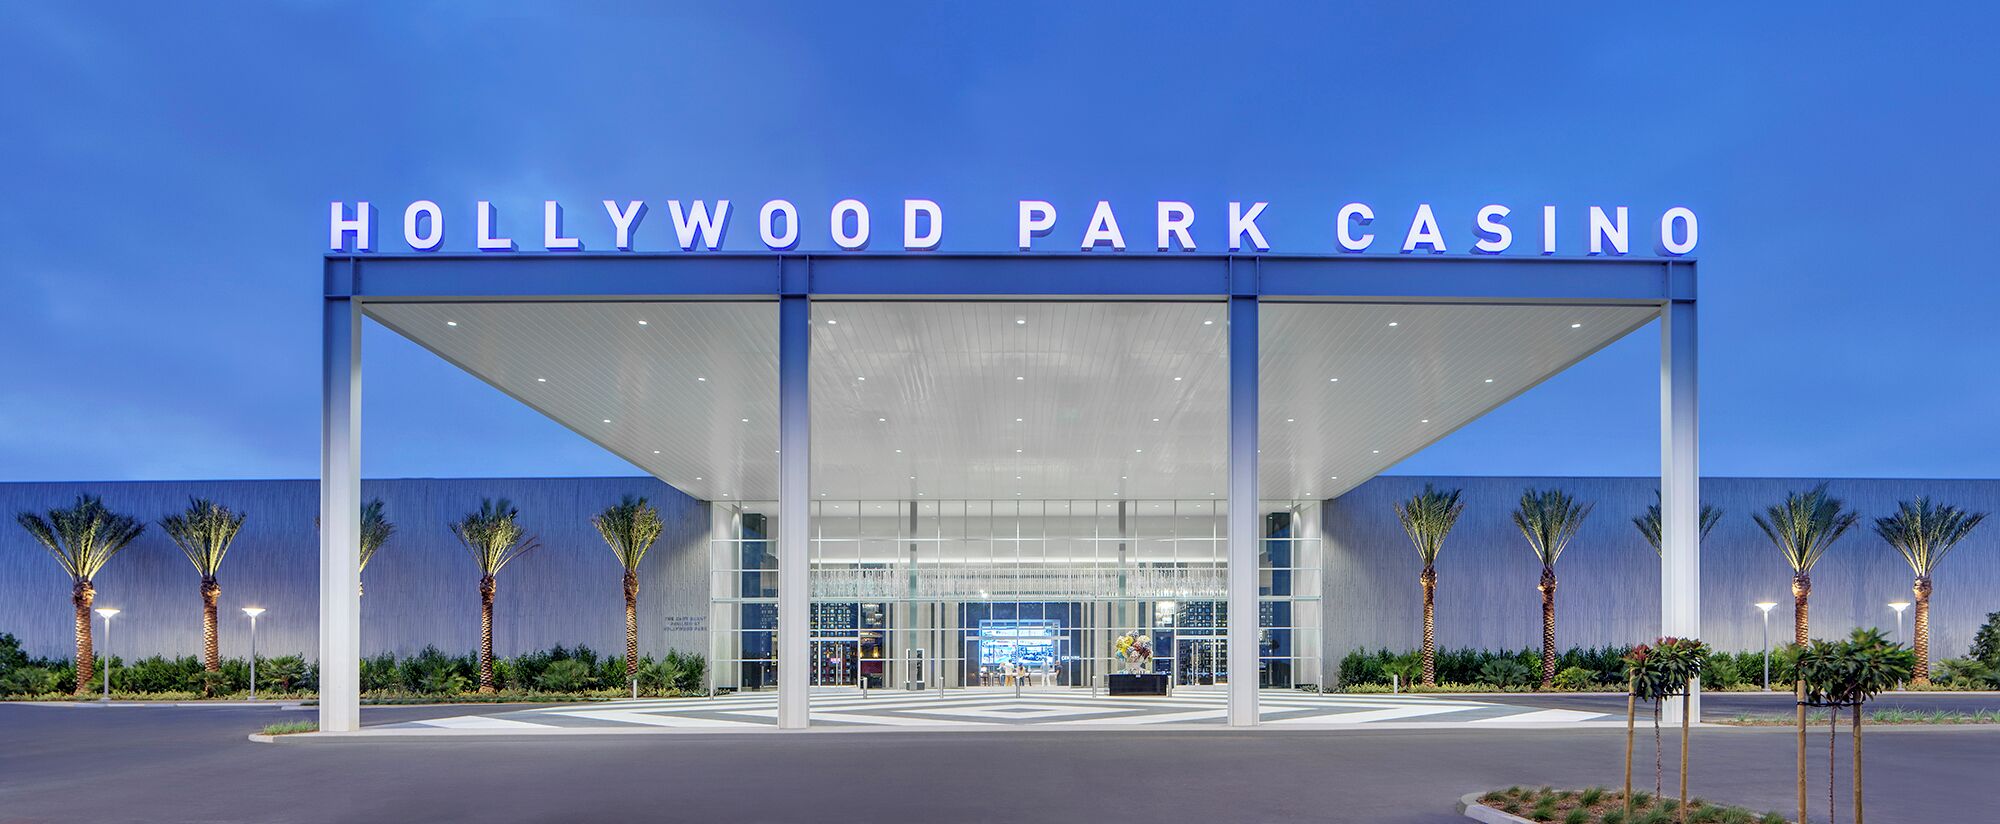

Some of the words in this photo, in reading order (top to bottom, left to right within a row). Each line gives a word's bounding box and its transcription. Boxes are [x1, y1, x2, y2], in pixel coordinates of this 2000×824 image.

[330, 200, 943, 251] HOLLYWOOD
[1018, 200, 1270, 250] PARK
[1336, 203, 1700, 255] CASINO
